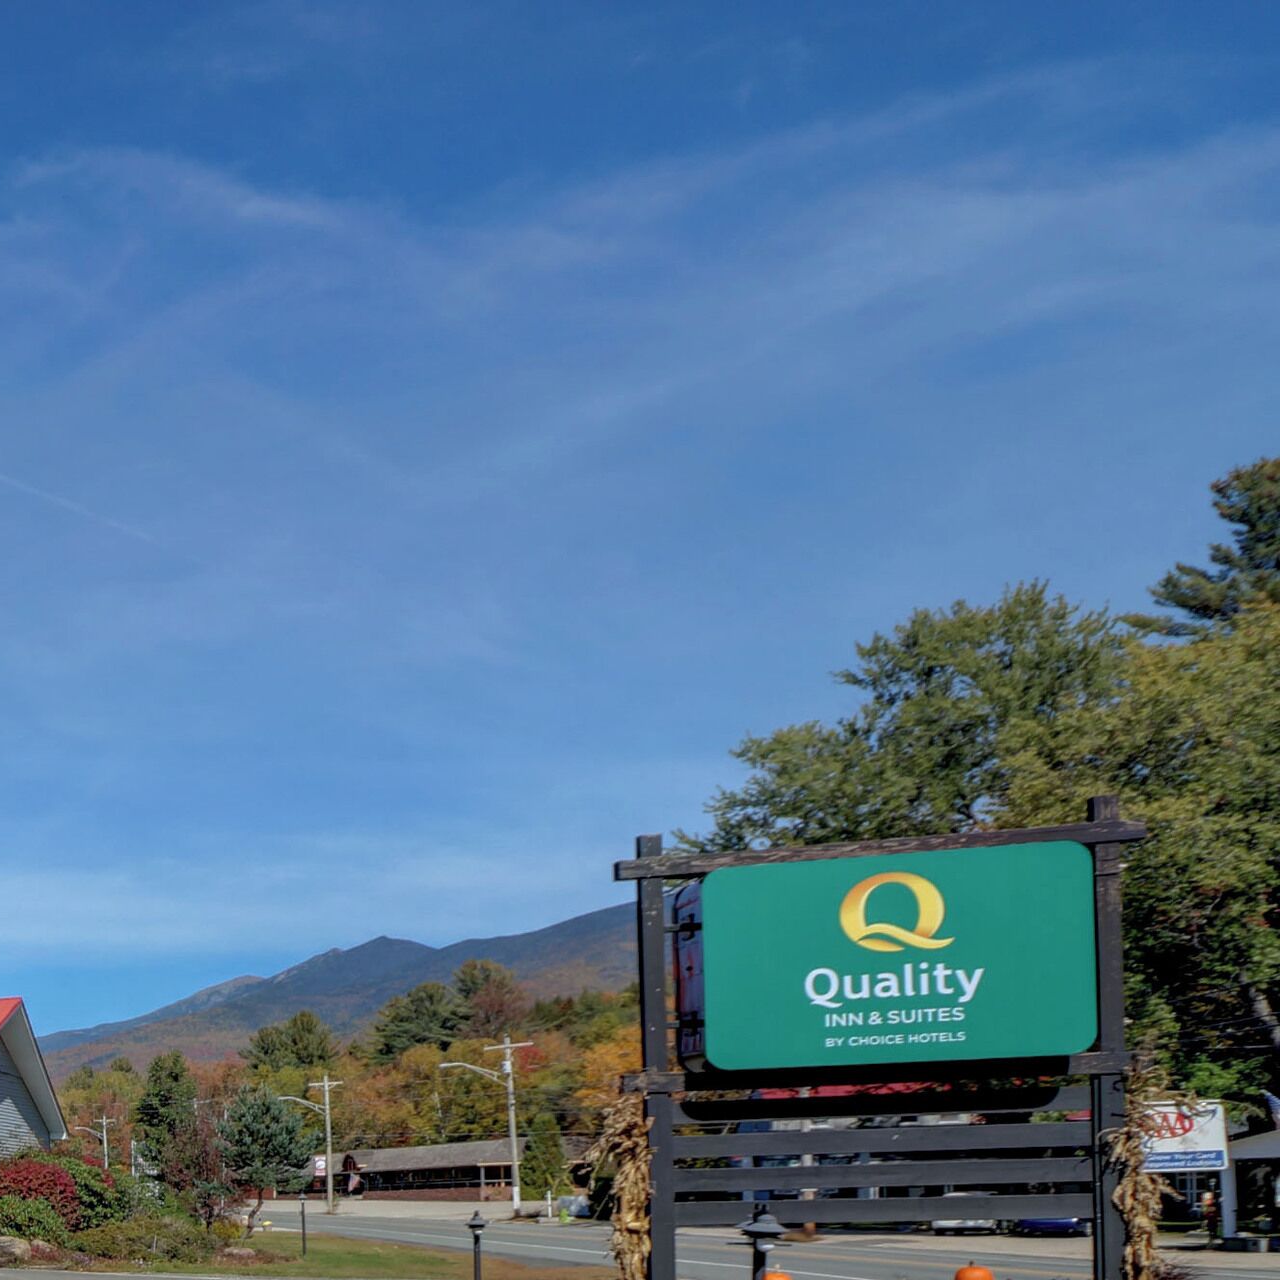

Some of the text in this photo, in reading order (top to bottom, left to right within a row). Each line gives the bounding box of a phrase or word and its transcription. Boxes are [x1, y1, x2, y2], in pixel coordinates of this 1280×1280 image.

[839, 871, 956, 952] Q
[804, 961, 986, 1009] Quality
[824, 1007, 965, 1027] INN & SUITES
[824, 1031, 966, 1048] BY CHOICE HOTELS
